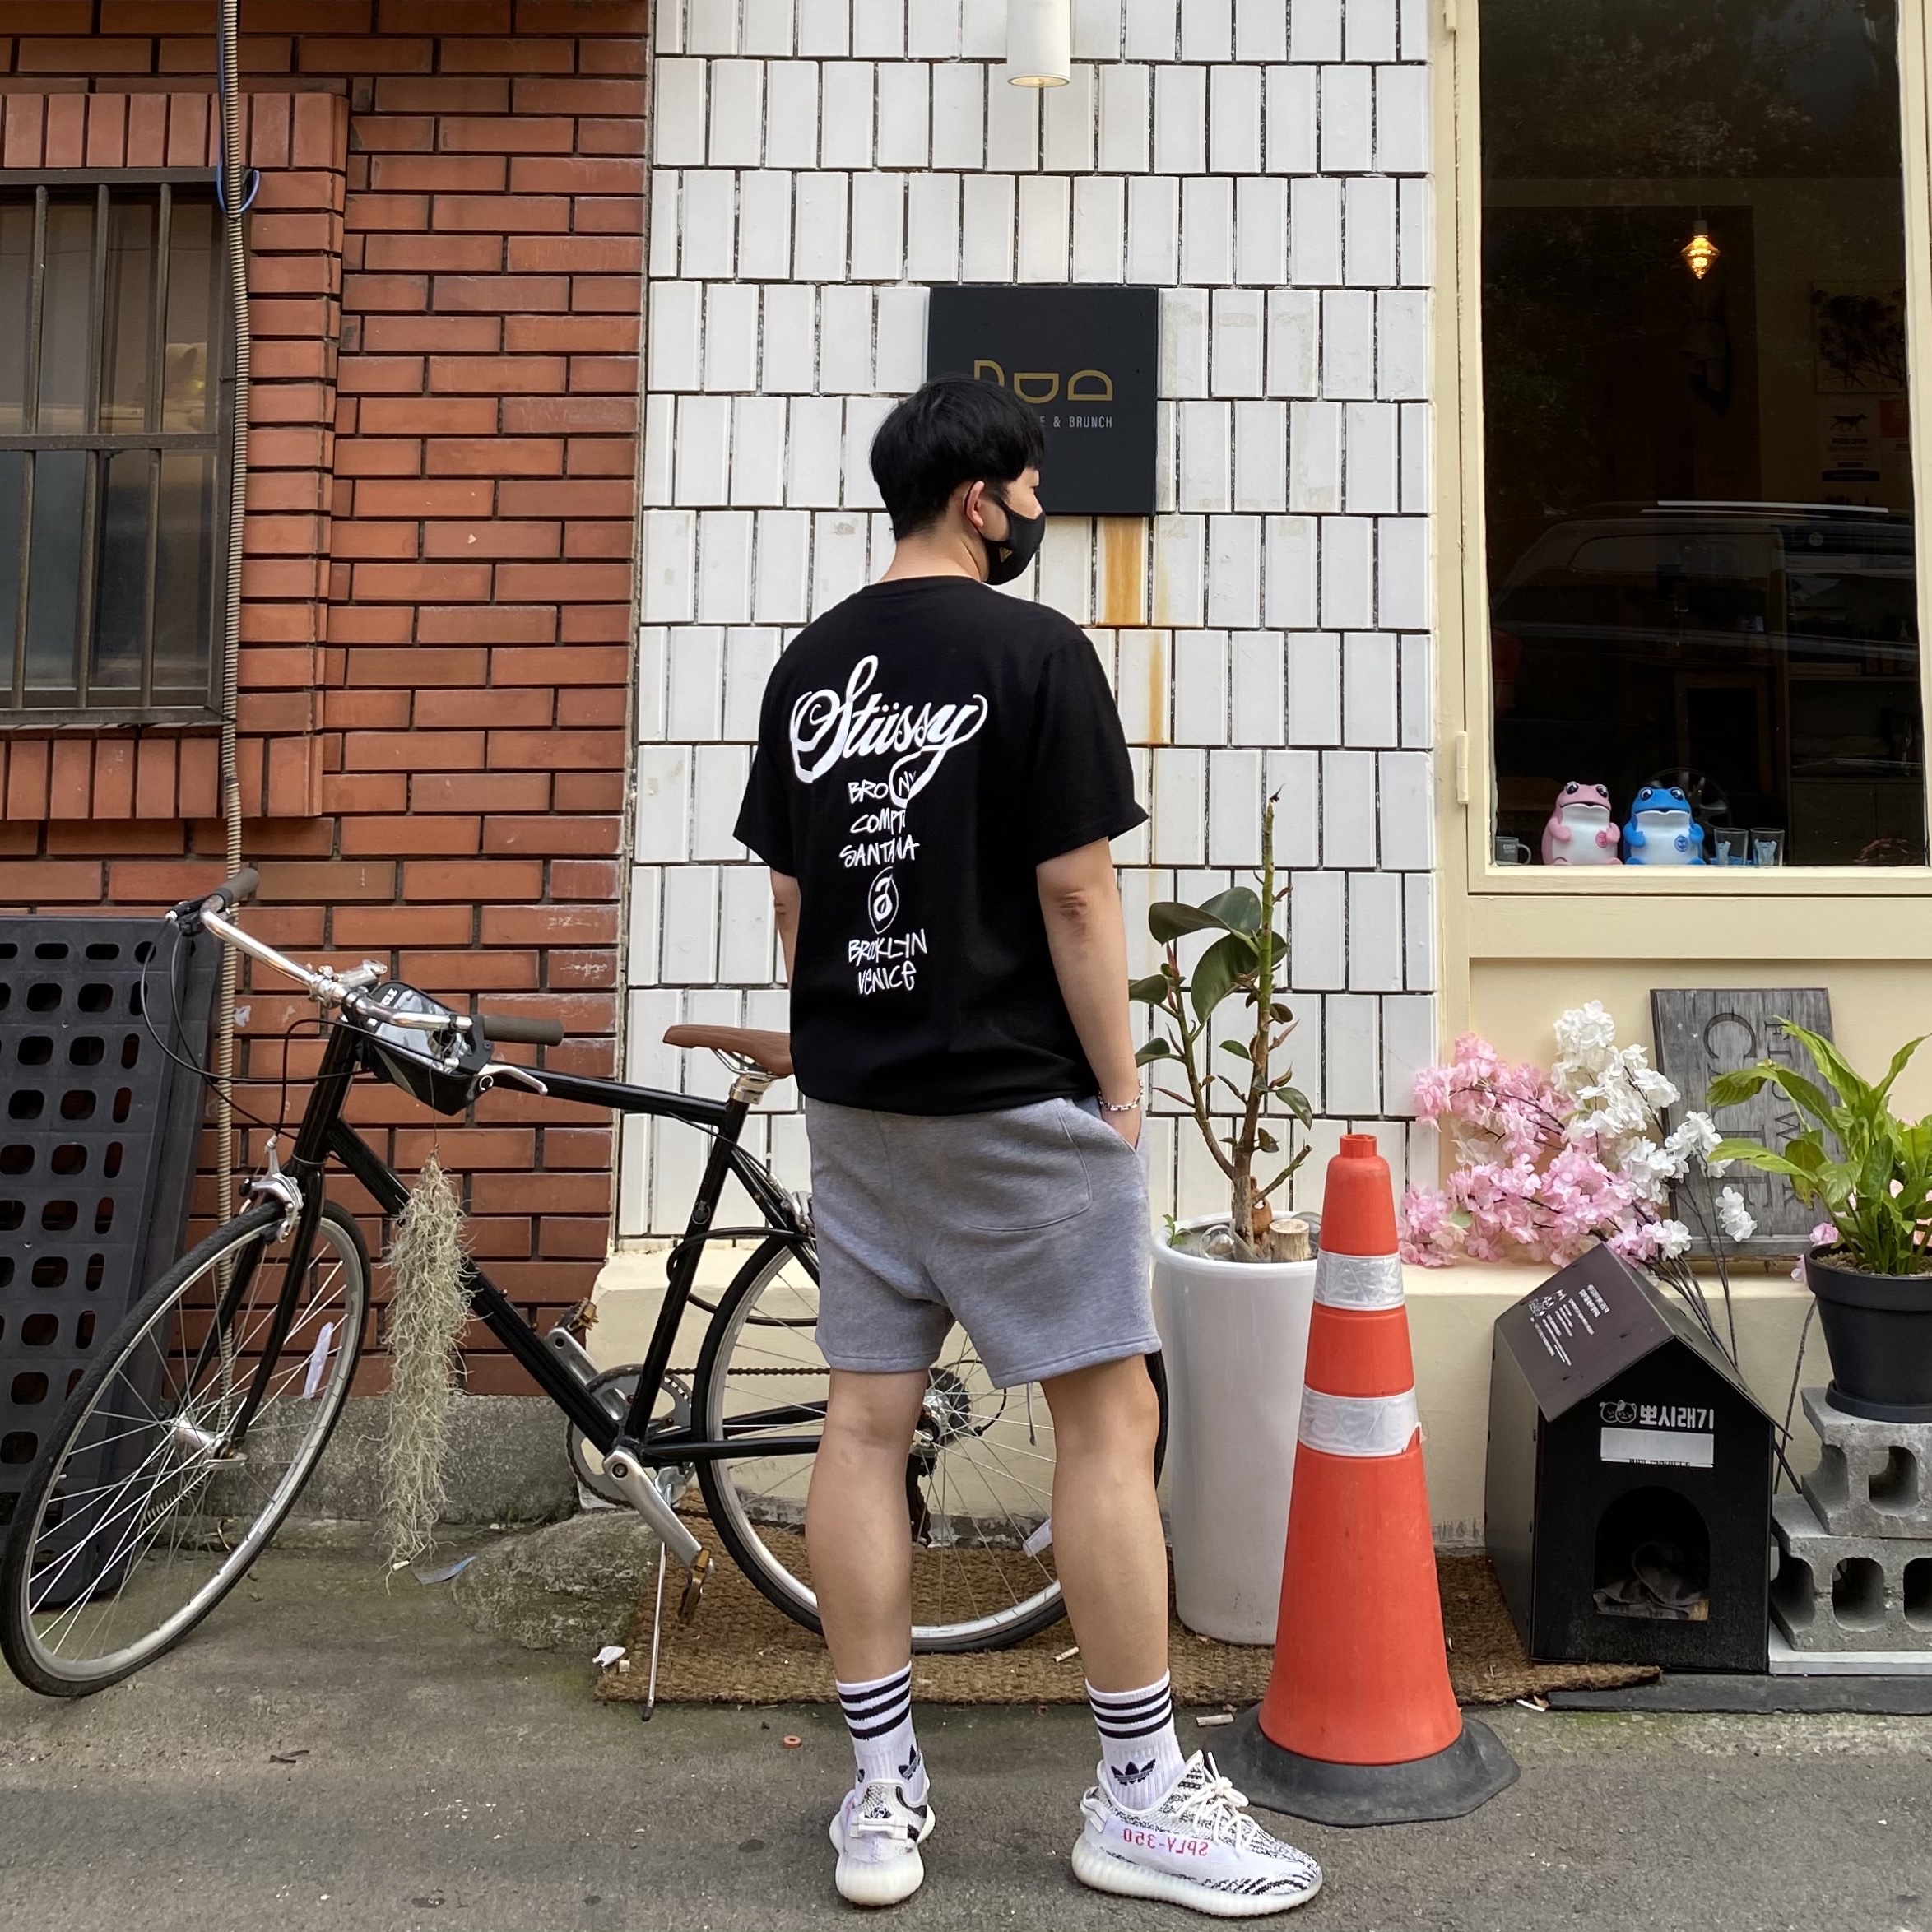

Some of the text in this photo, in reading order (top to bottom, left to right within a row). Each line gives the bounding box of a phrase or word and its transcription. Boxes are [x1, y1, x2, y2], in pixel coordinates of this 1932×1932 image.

[1053, 416, 1061, 428] &
[1069, 416, 1112, 428] BRUNCH
[1639, 1404, 1714, 1429] 뽀시래기
